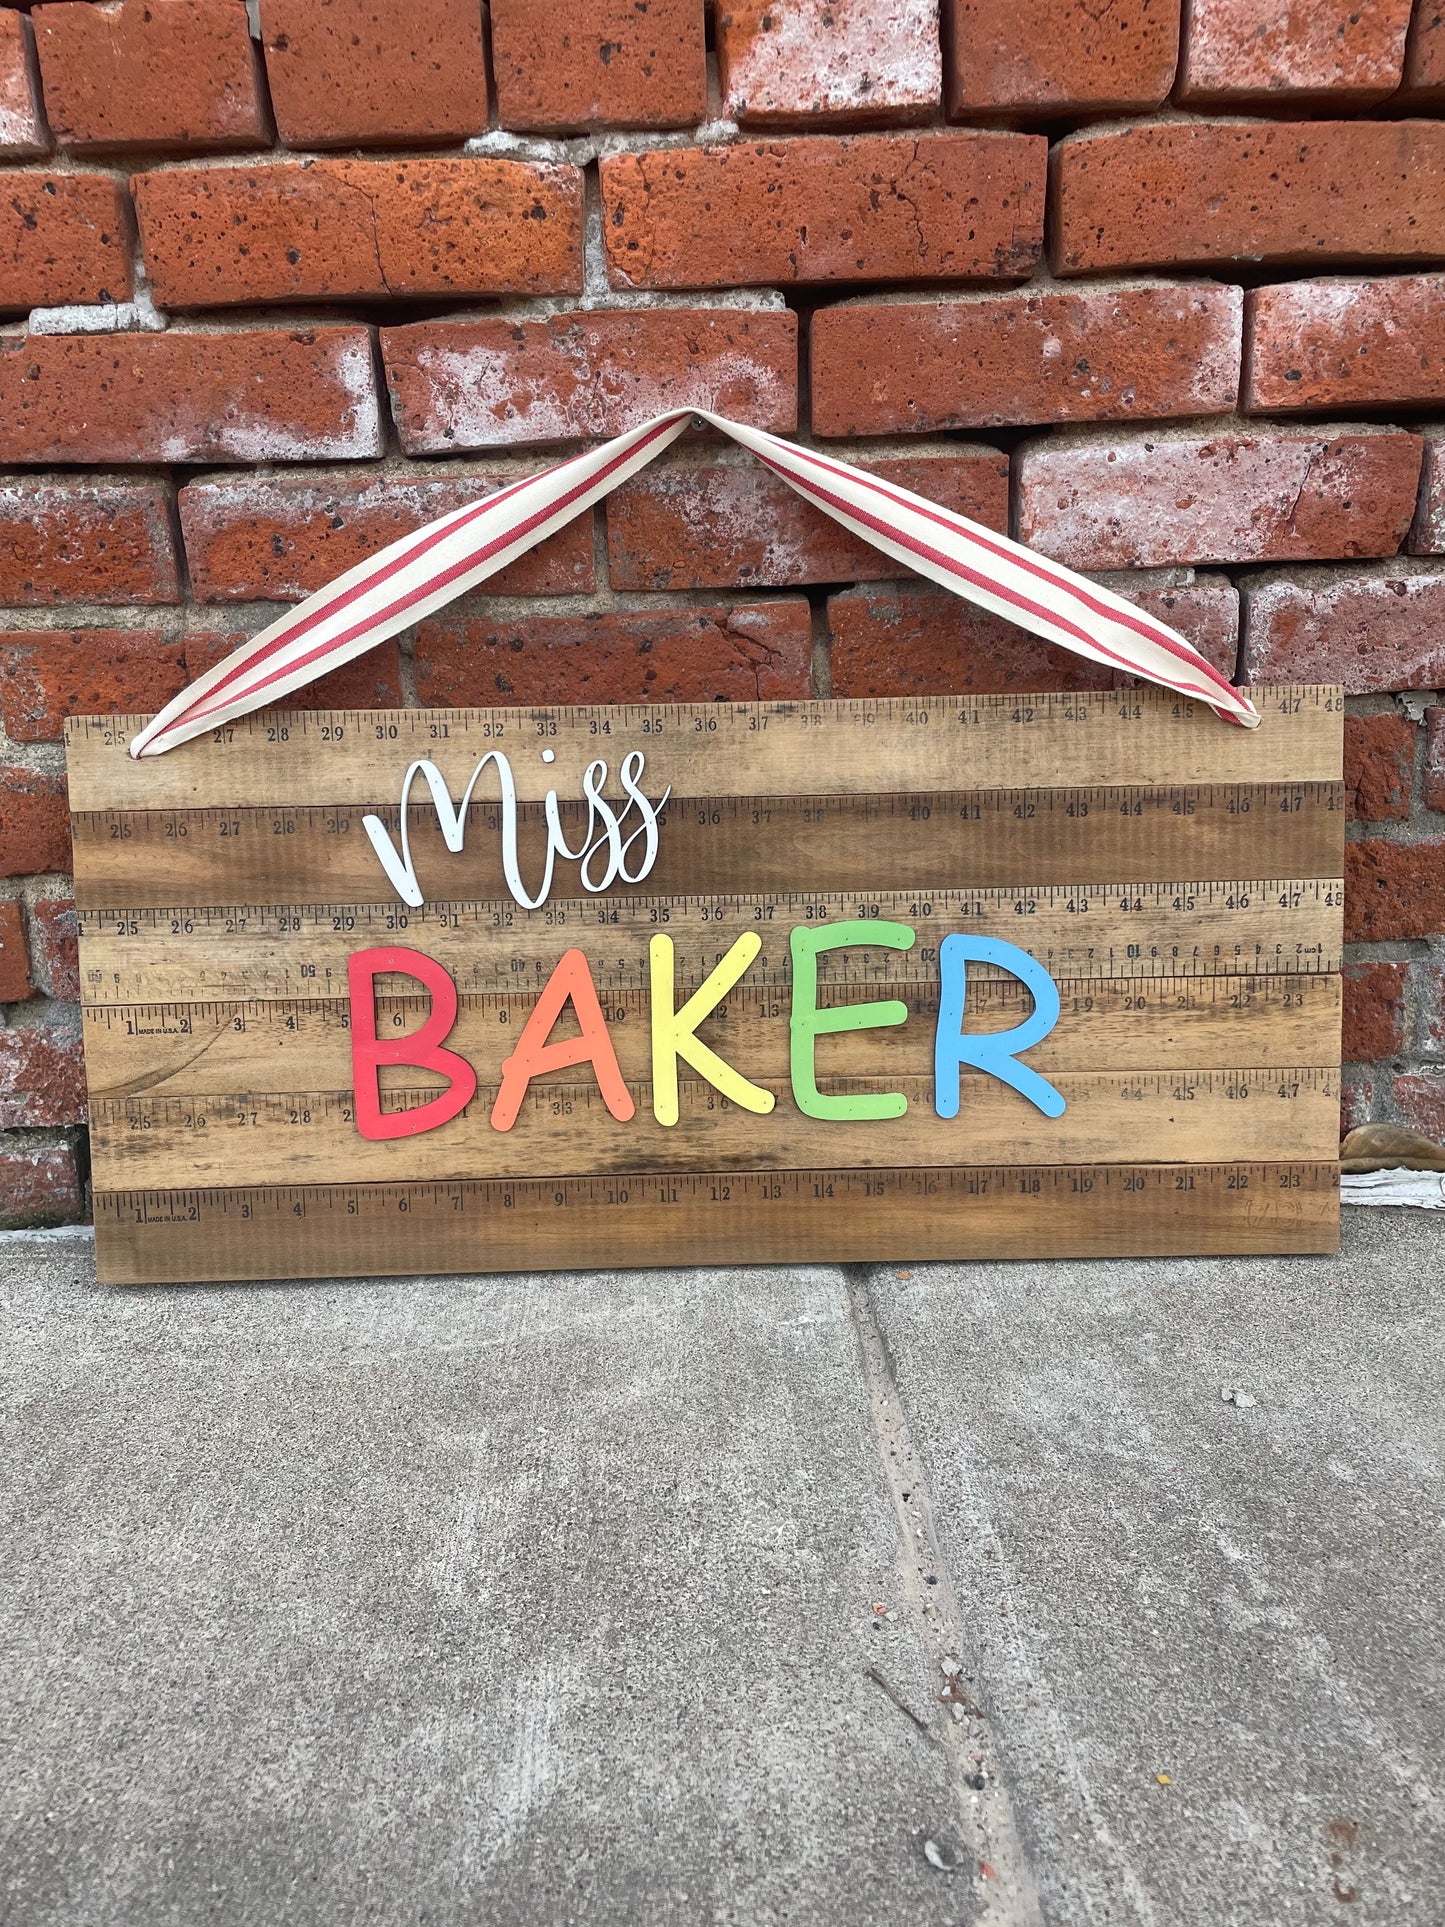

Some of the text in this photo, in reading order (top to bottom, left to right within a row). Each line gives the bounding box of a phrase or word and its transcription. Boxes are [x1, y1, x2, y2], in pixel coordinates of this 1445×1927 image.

[104, 731, 126, 746] 25
[214, 728, 234, 743] 27
[267, 727, 289, 742] 28
[321, 726, 344, 741] 29
[375, 725, 398, 740] 30
[430, 724, 450, 739] 31
[483, 723, 504, 737] 32
[537, 721, 557, 736] 33
[590, 720, 611, 735] 34
[643, 719, 663, 734] 35
[695, 717, 717, 732] 36
[749, 716, 769, 730] 37
[905, 711, 928, 725] 40
[958, 710, 980, 724] 41
[1012, 708, 1034, 723] 42
[1064, 707, 1087, 722] 43
[1118, 705, 1141, 719] 44
[1171, 703, 1193, 719] 45
[1279, 698, 1301, 714] 47
[1324, 697, 1343, 712] 48
[110, 824, 132, 839] 25
[165, 822, 188, 837] 26
[219, 821, 240, 836] 27
[273, 820, 295, 835] 28
[326, 820, 350, 835] 29
[698, 810, 721, 825] 36
[752, 809, 772, 824] 37
[907, 806, 930, 820] 40
[960, 805, 981, 819] 41
[1013, 804, 1035, 819] 42
[1066, 802, 1088, 817] 43
[1119, 801, 1142, 816] 44
[1172, 799, 1195, 815] 45
[1226, 797, 1250, 813] 46
[1280, 796, 1303, 812] 47
[362, 750, 672, 910] Miss
[117, 891, 1343, 936] 25 26 27 28 29 30 31 32 33 34 35 36 37 38 39 40 41 42 43 44 45 46 47 48
[126, 1021, 134, 1034] 1
[179, 1019, 189, 1033] 2
[234, 1017, 242, 1031] 3
[285, 1016, 296, 1030] 4
[341, 1014, 349, 1028] 5
[393, 1012, 402, 1026] 6
[499, 1010, 507, 1024] 8
[759, 1004, 779, 1018] 13
[1072, 998, 1094, 1012] 19
[1124, 997, 1146, 1010] 20
[1177, 996, 1196, 1009] 21
[1230, 994, 1250, 1008] 22
[1283, 994, 1303, 1007] 23
[348, 918, 1066, 1142] BAKER
[130, 1116, 151, 1130] 25
[183, 1114, 206, 1128] 26
[237, 1112, 258, 1126] 27
[290, 1110, 311, 1124] 28
[553, 1101, 572, 1116] 33
[707, 1096, 729, 1110] 36
[1172, 1086, 1194, 1100] 45
[1226, 1084, 1248, 1099] 46
[1277, 1083, 1299, 1099] 47
[135, 1210, 143, 1223] 1
[188, 1207, 197, 1221] 2
[242, 1204, 250, 1218] 3
[293, 1202, 302, 1216] 4
[347, 1201, 355, 1214] 5
[398, 1198, 408, 1212] 6
[451, 1197, 460, 1210] 7
[504, 1194, 512, 1208] 8
[554, 1192, 564, 1206] 9
[607, 1190, 628, 1204] 10
[659, 1189, 678, 1202] 11
[710, 1186, 730, 1200] 12
[762, 1185, 782, 1199] 13
[813, 1184, 834, 1198] 14
[864, 1182, 885, 1196] 15
[968, 1179, 989, 1194] 17
[1019, 1179, 1041, 1192] 18
[1071, 1178, 1093, 1192] 19
[1123, 1177, 1144, 1191] 20
[1175, 1176, 1196, 1190] 21
[1227, 1175, 1248, 1189] 22
[1279, 1174, 1300, 1188] 23
